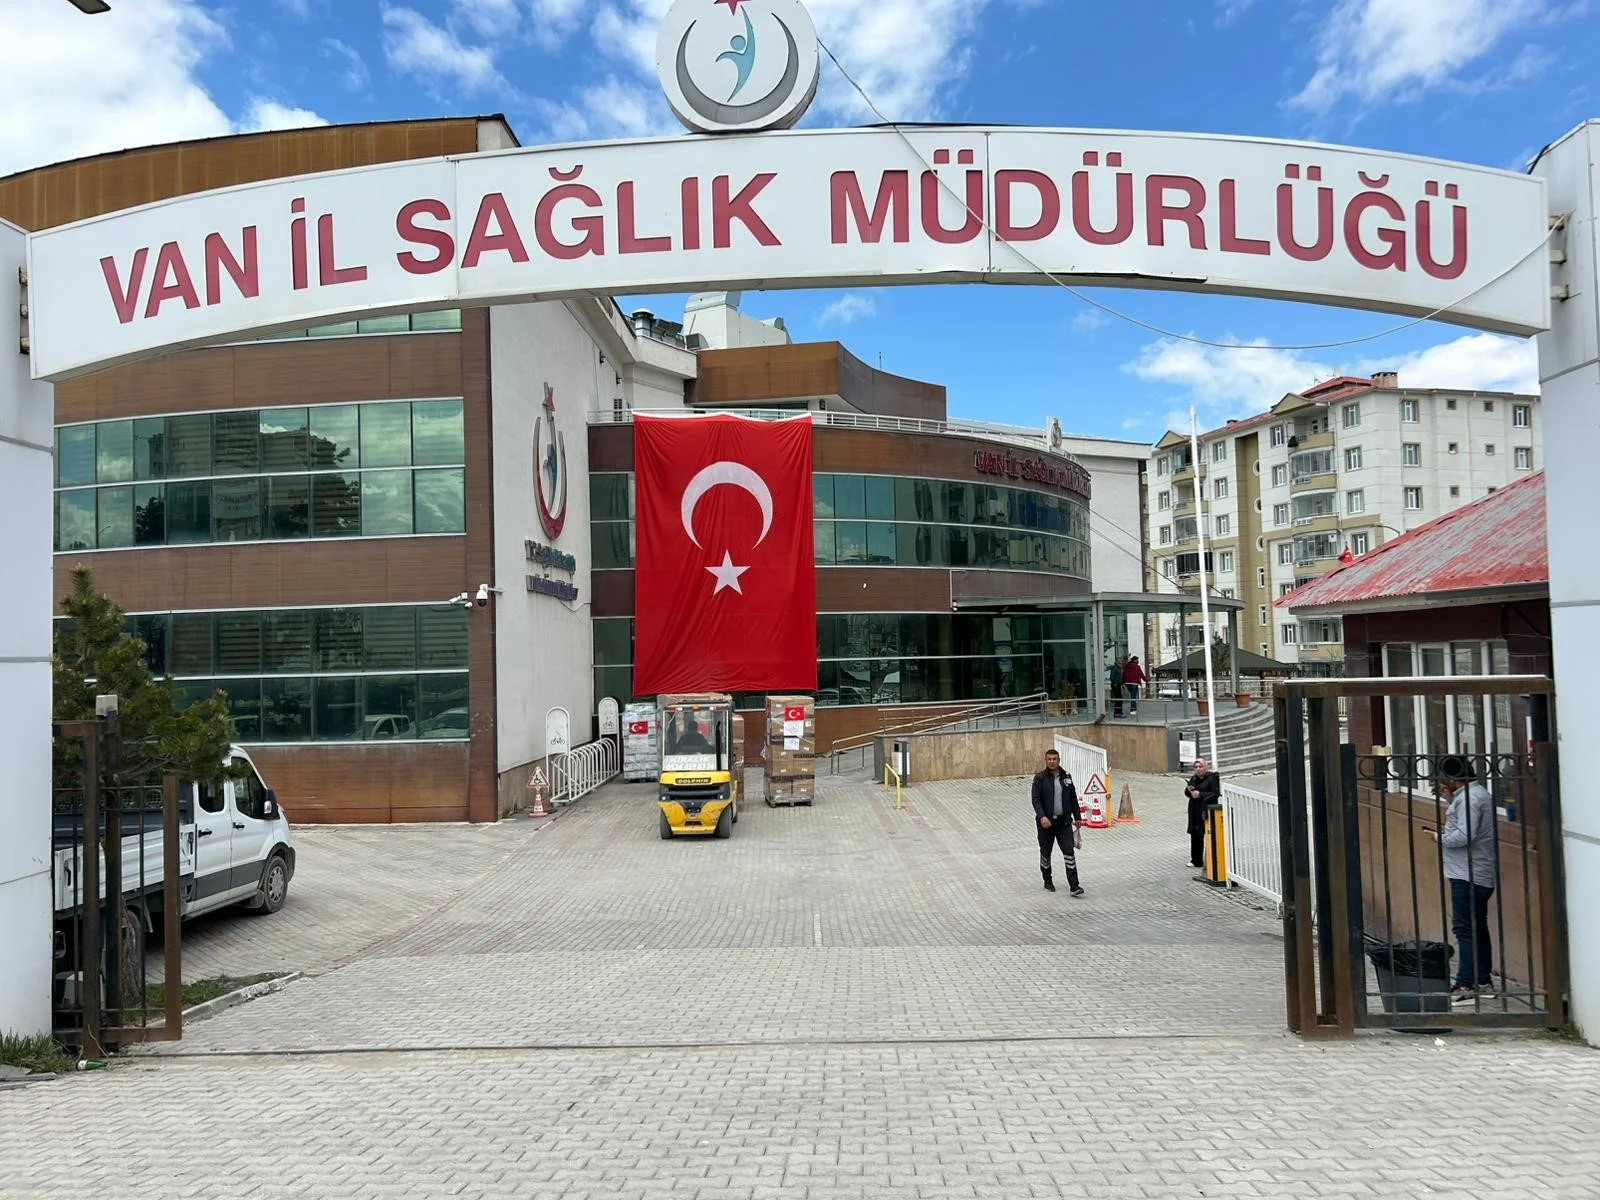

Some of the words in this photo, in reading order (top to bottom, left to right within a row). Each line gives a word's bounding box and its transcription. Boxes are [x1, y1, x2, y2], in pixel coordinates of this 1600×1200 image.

[101, 227, 258, 322] VAN
[292, 198, 367, 289] İL
[396, 165, 782, 275] SAĞLIK
[831, 149, 1467, 280] MÜDÜRLÜĞÜ
